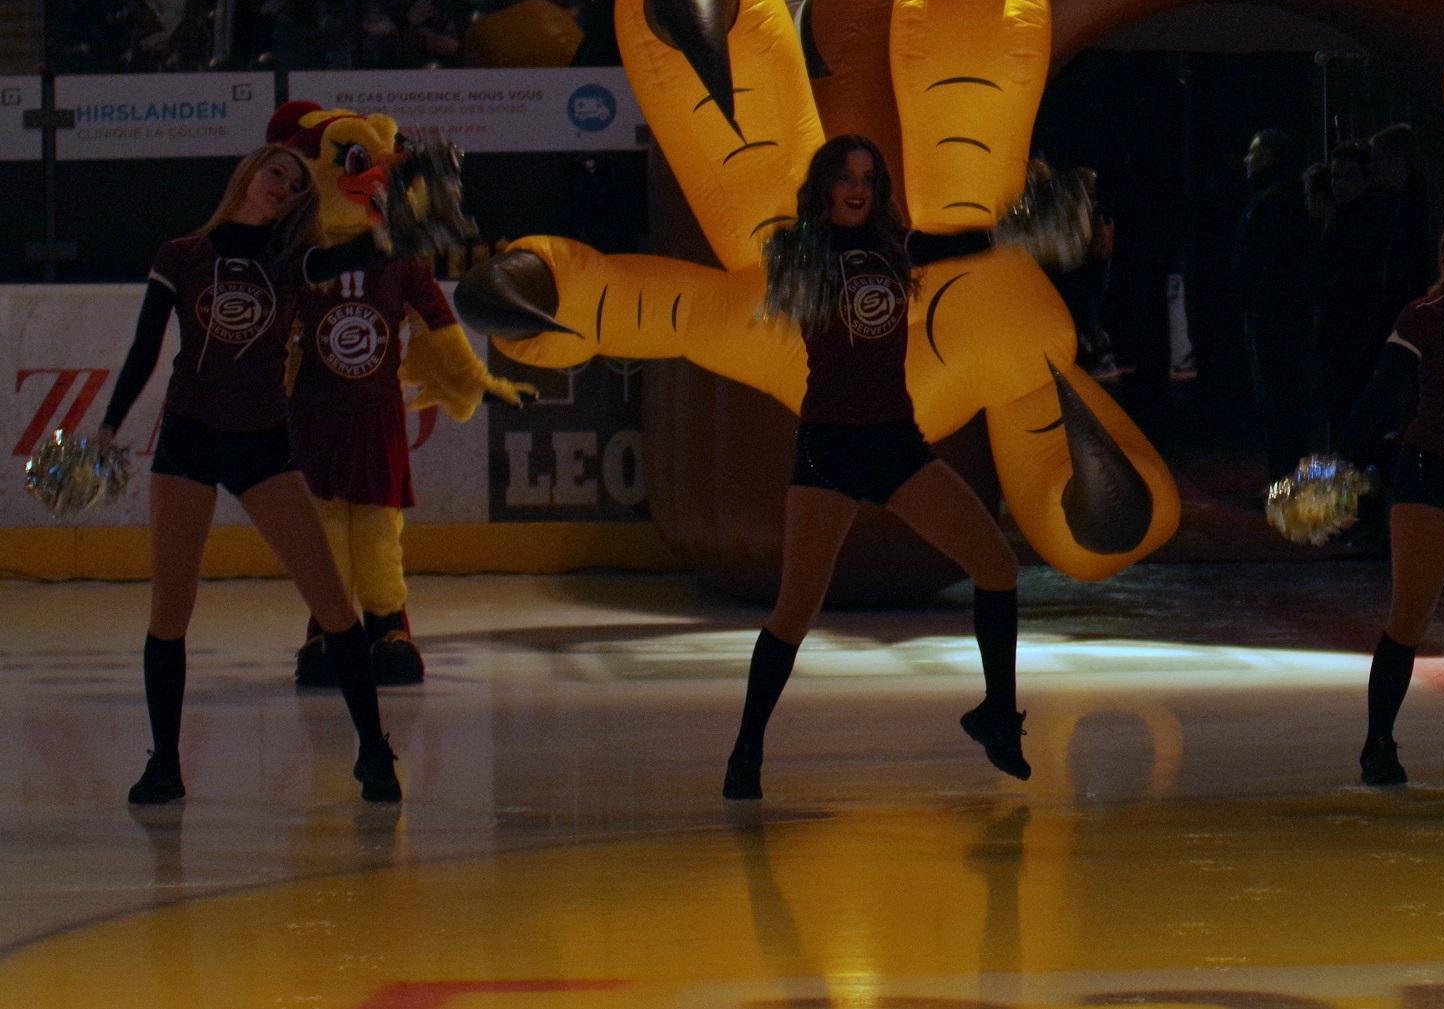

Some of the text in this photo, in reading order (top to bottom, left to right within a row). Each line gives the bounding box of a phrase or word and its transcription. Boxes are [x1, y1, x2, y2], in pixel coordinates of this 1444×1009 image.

[336, 93, 353, 104] EN
[357, 92, 383, 103] CAS
[468, 90, 504, 101] NOUS
[508, 89, 543, 100] VOUS
[76, 101, 226, 122] HIRSLANDEN
[146, 126, 163, 138] LA
[327, 353, 380, 374] SERVETTE
